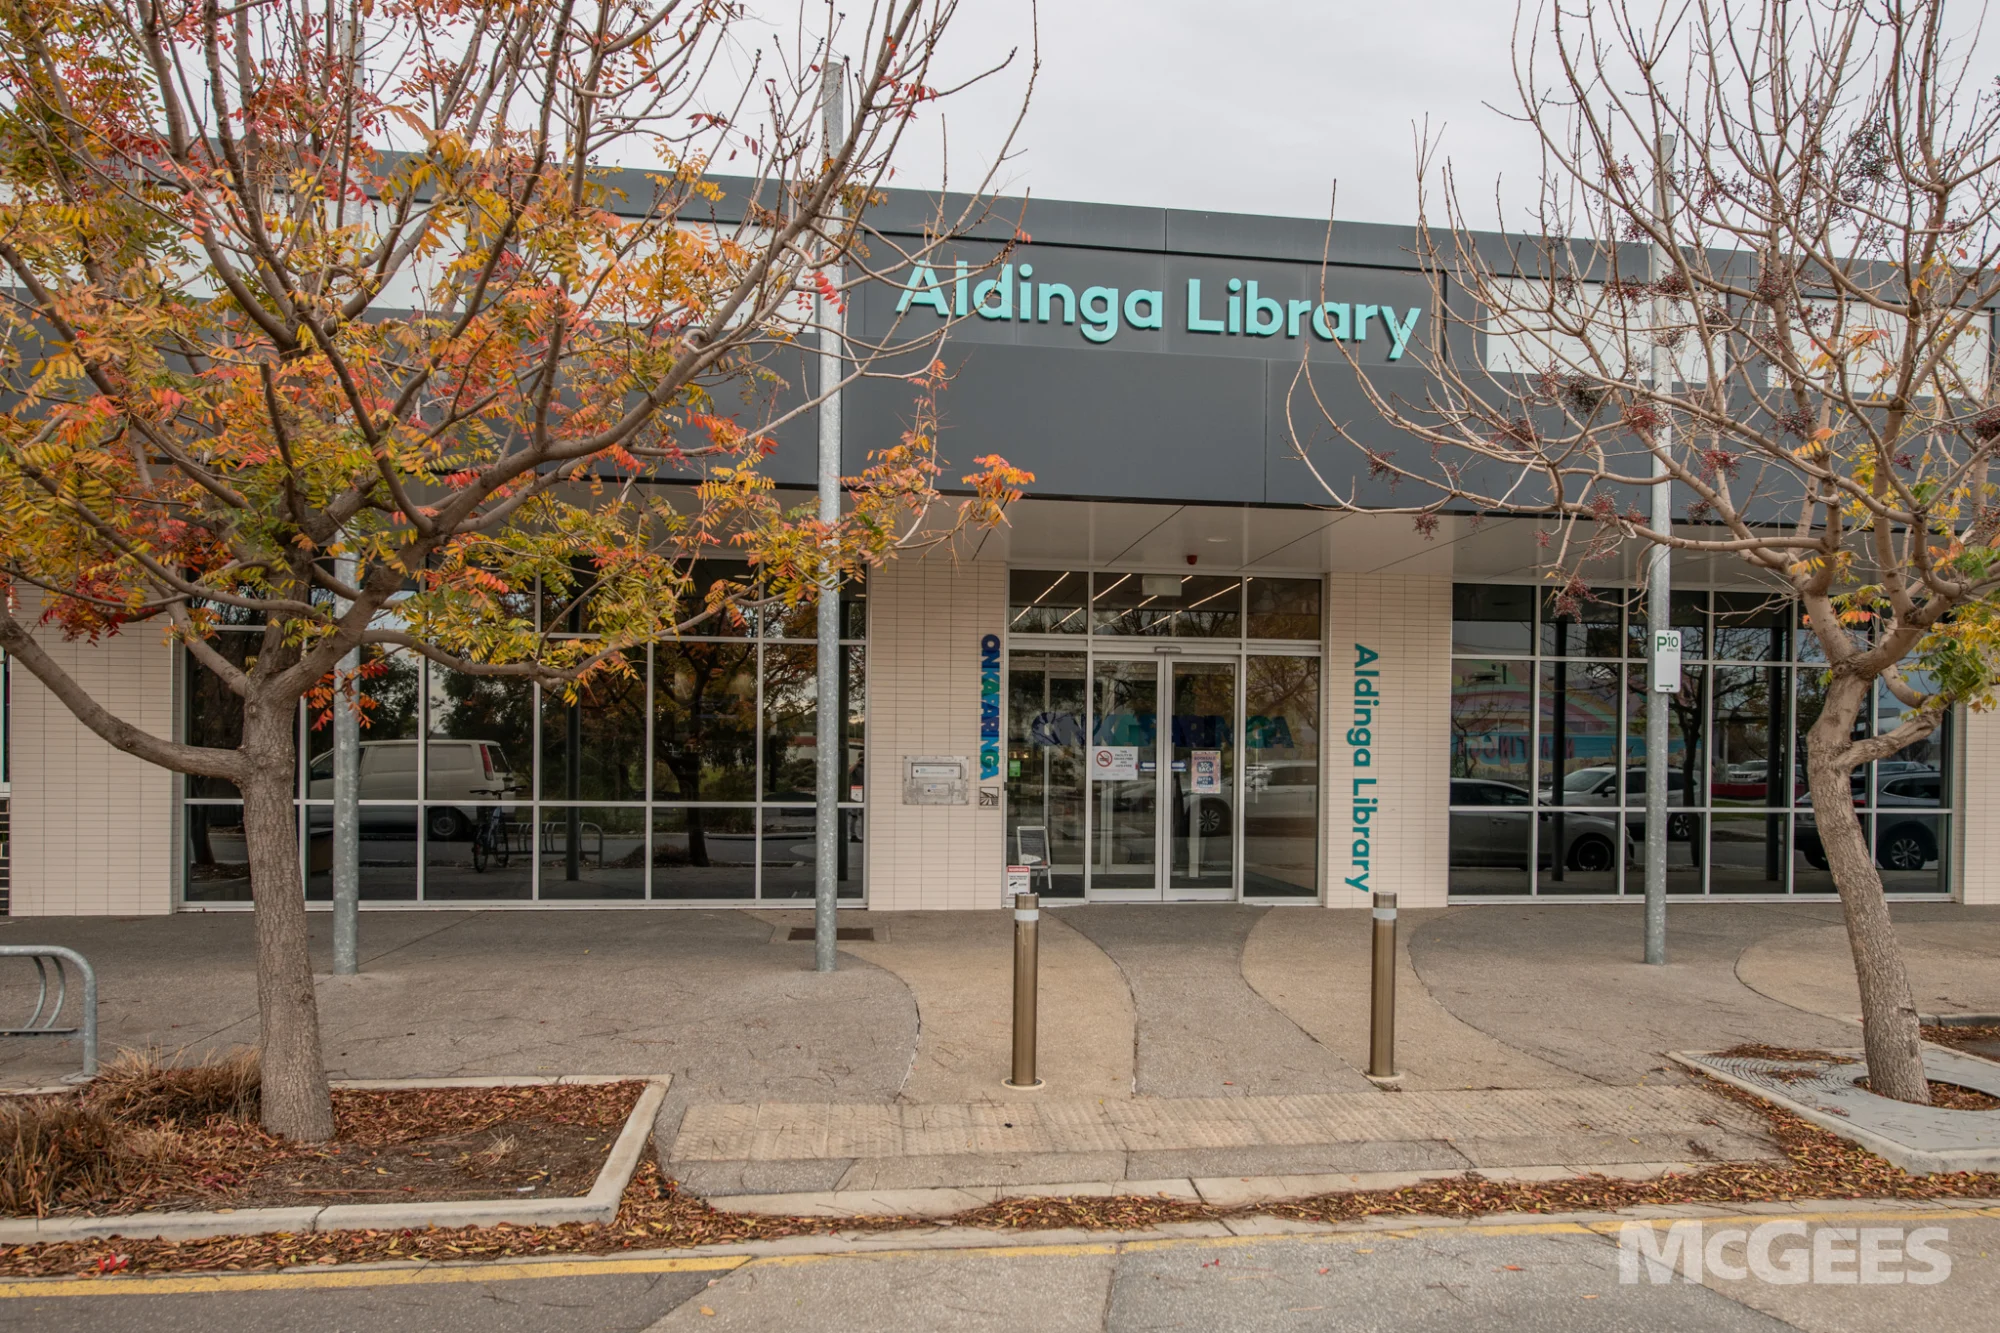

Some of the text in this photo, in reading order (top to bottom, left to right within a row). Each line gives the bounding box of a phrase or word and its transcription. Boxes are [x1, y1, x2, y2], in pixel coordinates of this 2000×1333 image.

[895, 259, 1422, 360] Aldinga Library
[980, 634, 1000, 780] ONKAPARINGA
[1344, 643, 1380, 893] Aldinga Library
